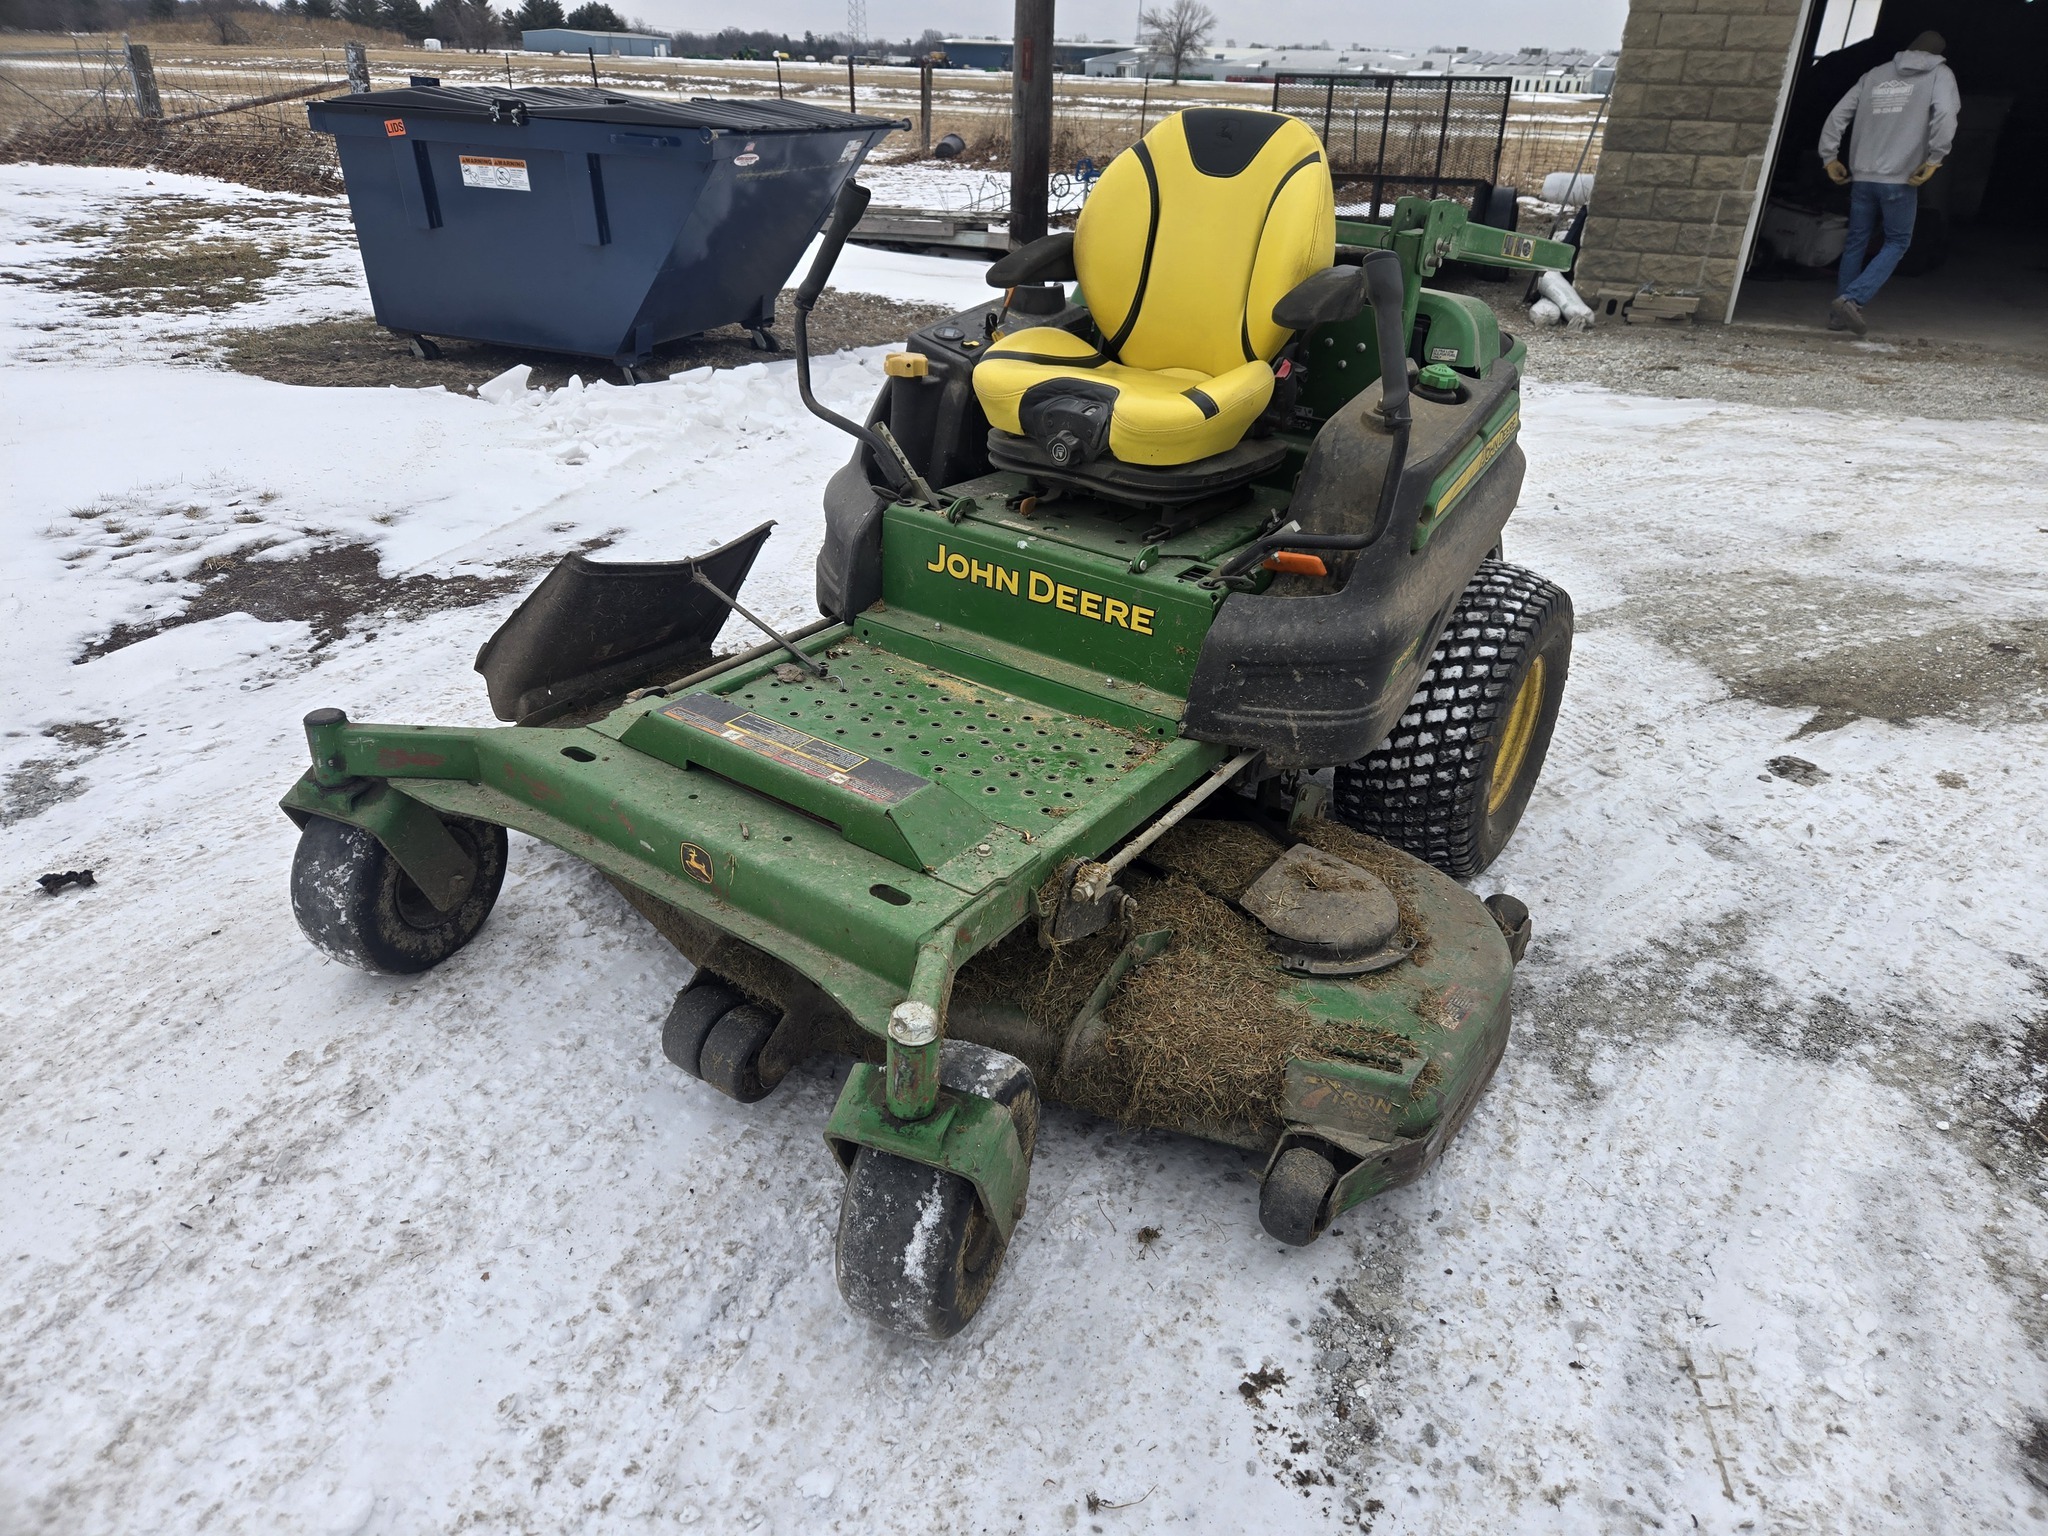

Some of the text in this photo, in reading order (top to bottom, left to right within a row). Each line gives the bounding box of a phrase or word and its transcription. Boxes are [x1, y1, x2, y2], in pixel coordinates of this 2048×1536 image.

[386, 121, 405, 134] LIDS
[466, 157, 493, 166] WARNING
[498, 159, 525, 169] WARNING
[927, 543, 1157, 636] JOHN DEERE
